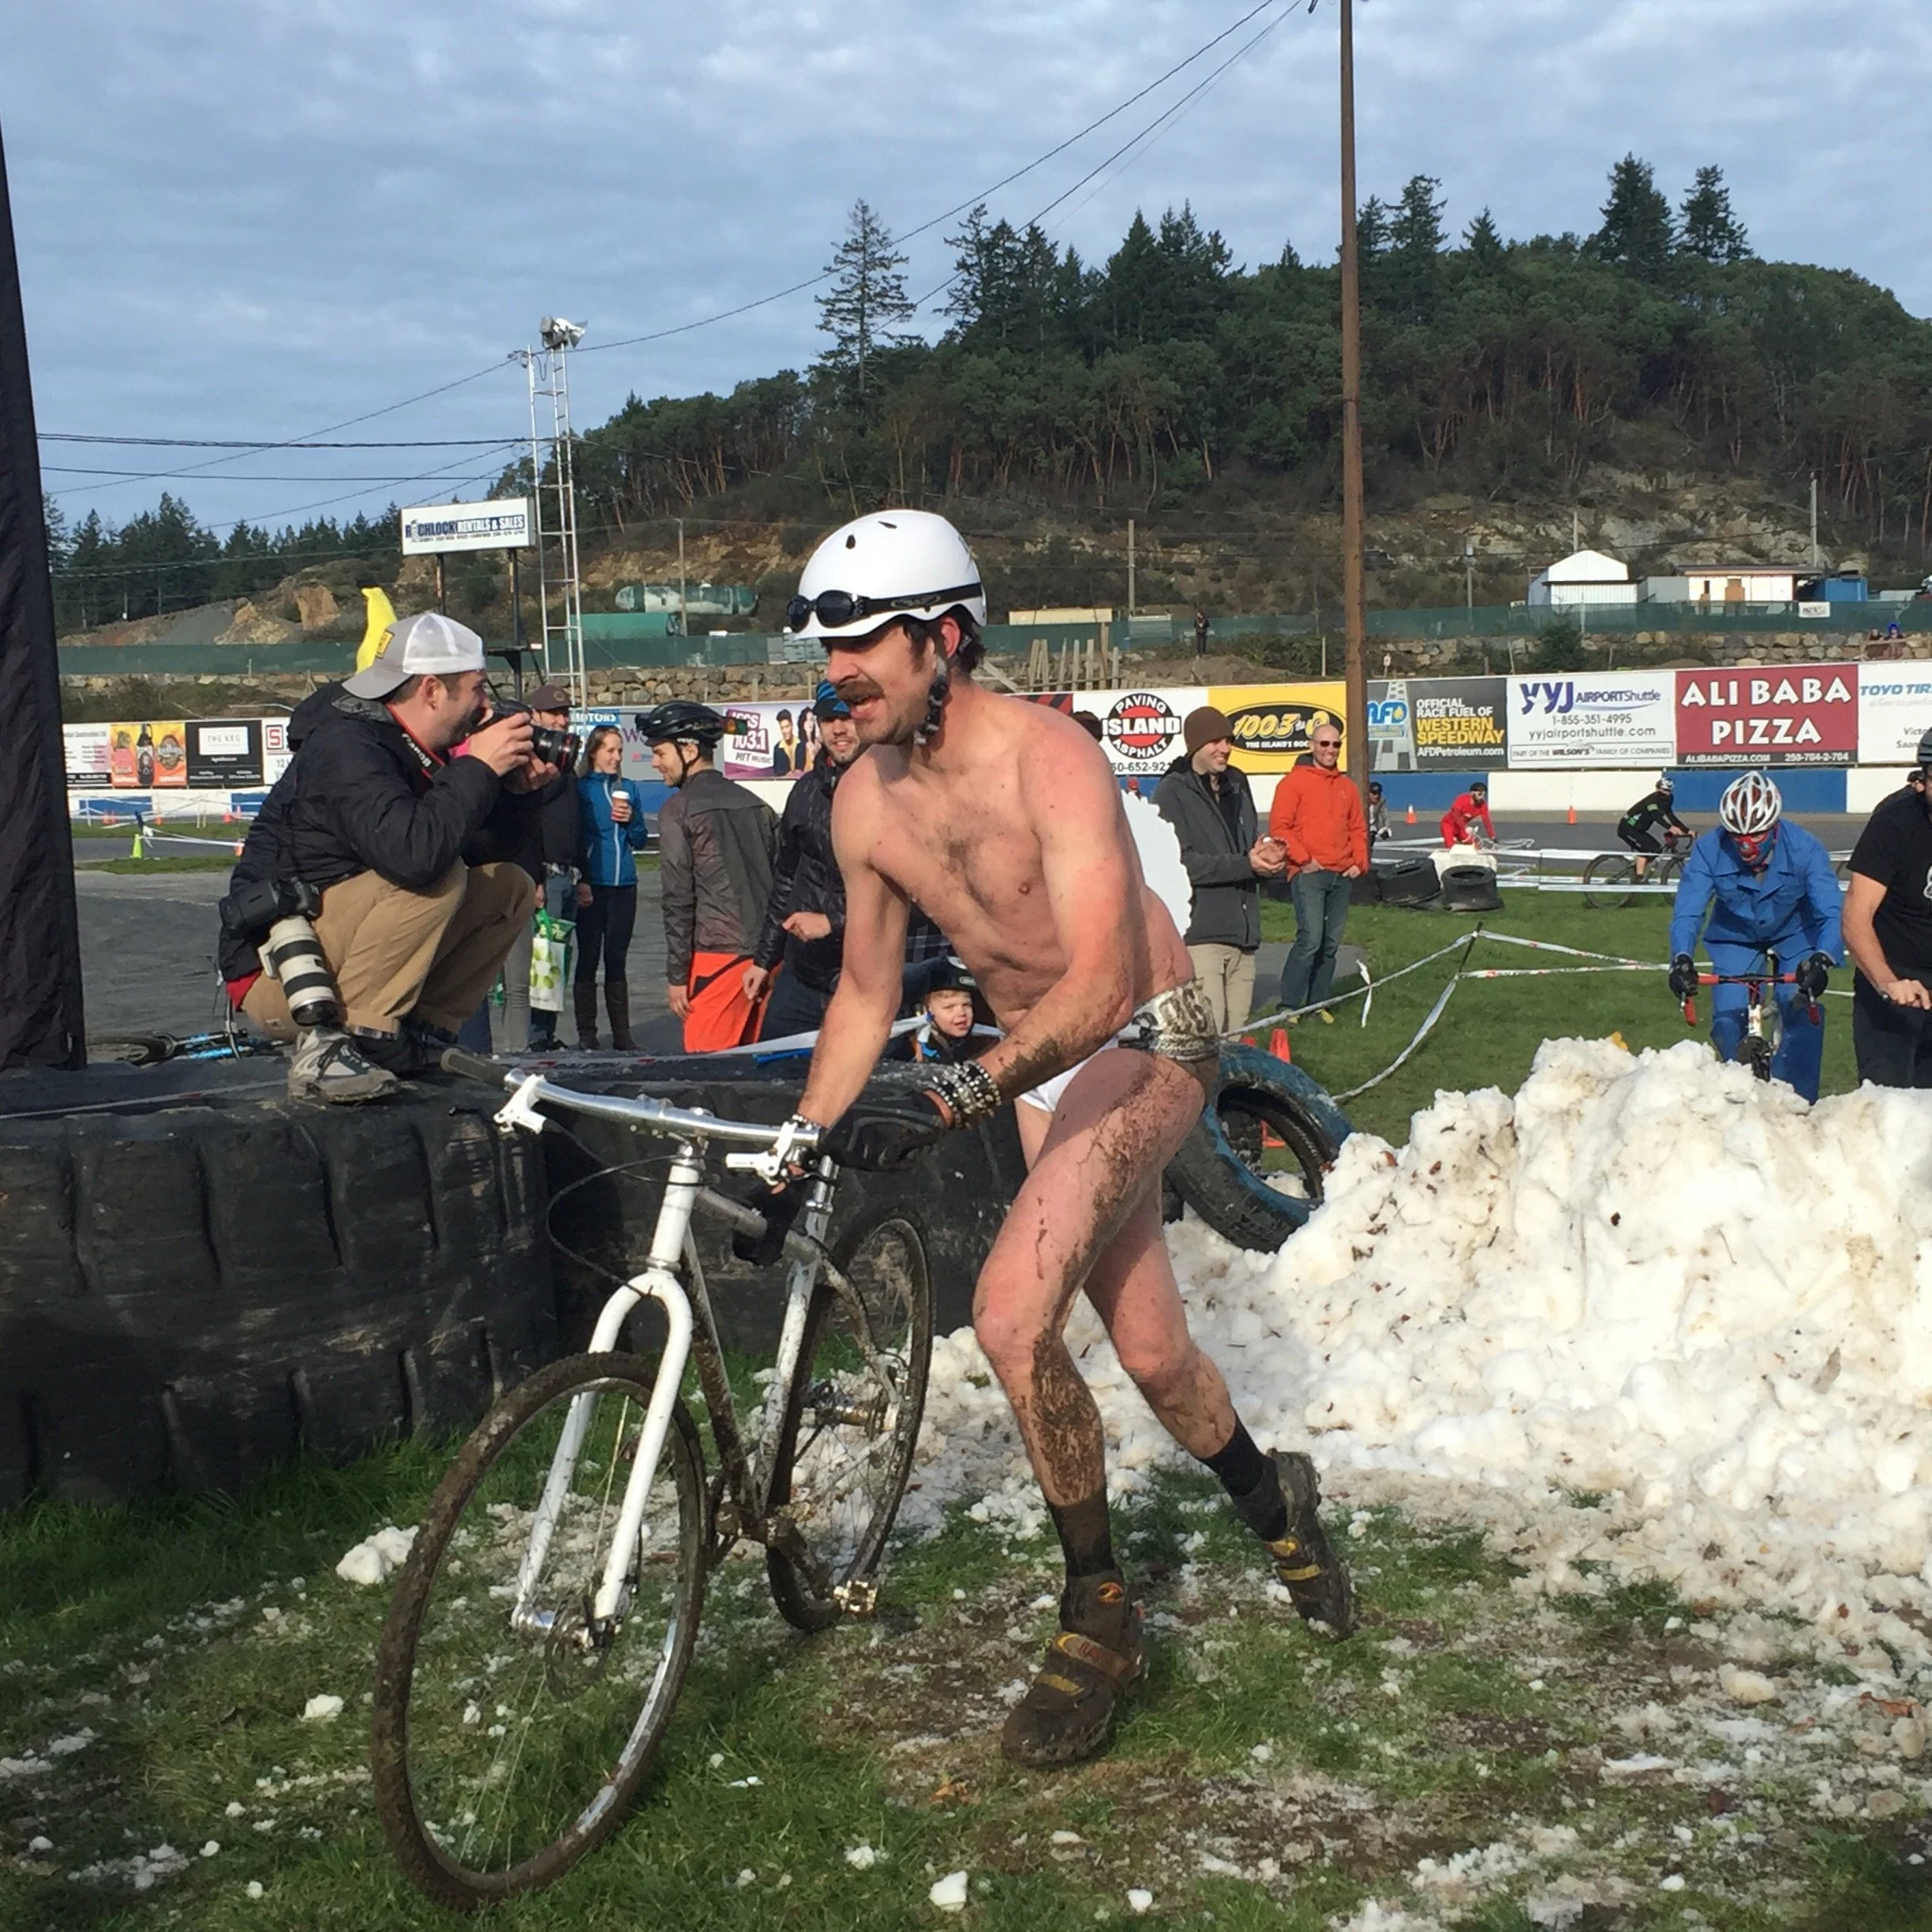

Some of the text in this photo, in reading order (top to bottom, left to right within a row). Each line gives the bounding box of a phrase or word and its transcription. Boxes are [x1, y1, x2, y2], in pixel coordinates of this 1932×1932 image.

[492, 519, 498, 530] &
[499, 515, 523, 530] SALES
[1681, 676, 1852, 708] ALI BABA
[1860, 683, 1932, 696] TOYO TIR
[1115, 695, 1167, 714] PAVING
[1416, 698, 1465, 710] OFFICIAL
[1416, 706, 1493, 718] RACE FUEL OF
[1552, 713, 1632, 725] 1-855-351-4995
[1102, 717, 1181, 736] ISLAND
[1417, 717, 1494, 732] WESTERN
[1712, 717, 1822, 745] PIZZA
[1417, 729, 1504, 745] SPEEDWAY
[1529, 726, 1657, 740] yyjairportshuttle.com
[1113, 737, 1167, 758] ASPHALT
[1896, 739, 1919, 749] Saan
[1417, 746, 1504, 758] AFDPetroleum.com
